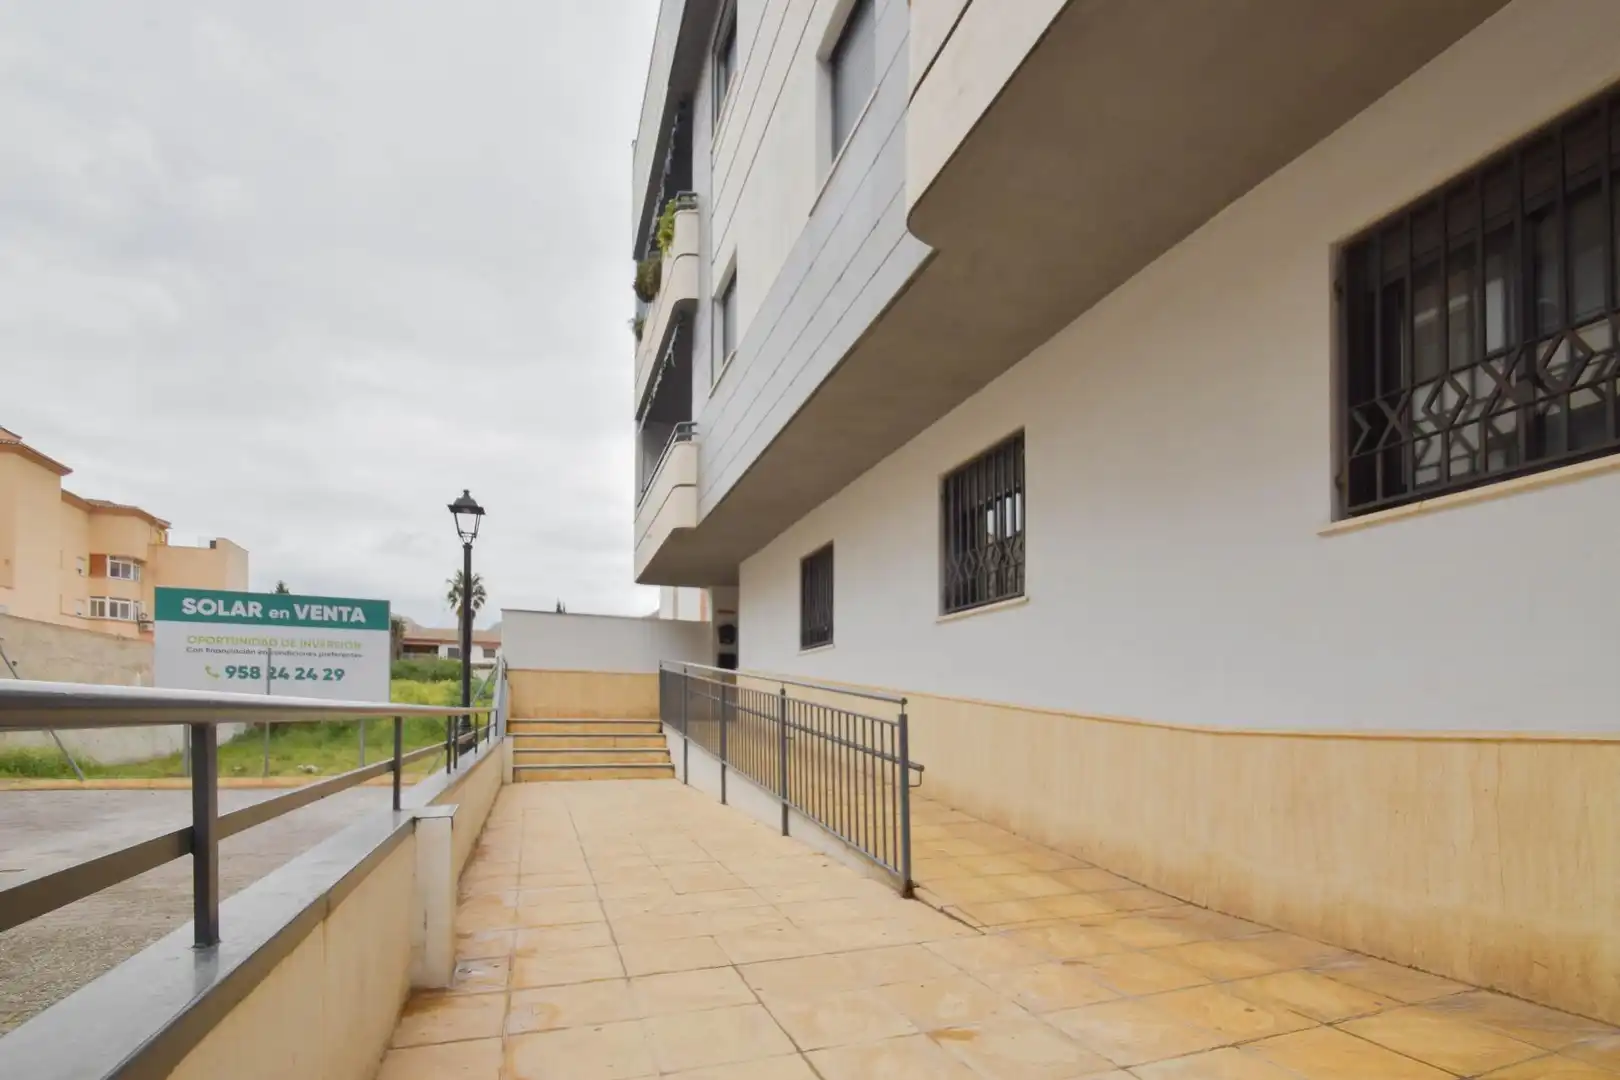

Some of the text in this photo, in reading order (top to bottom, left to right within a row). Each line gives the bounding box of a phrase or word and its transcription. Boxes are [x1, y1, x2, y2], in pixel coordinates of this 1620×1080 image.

[182, 597, 366, 623] SOLAR en VENTA
[187, 635, 278, 647] OPORTUNIDAD
[281, 637, 297, 648] DE
[185, 646, 204, 654] Con
[225, 665, 345, 682] 958 24 24 29
